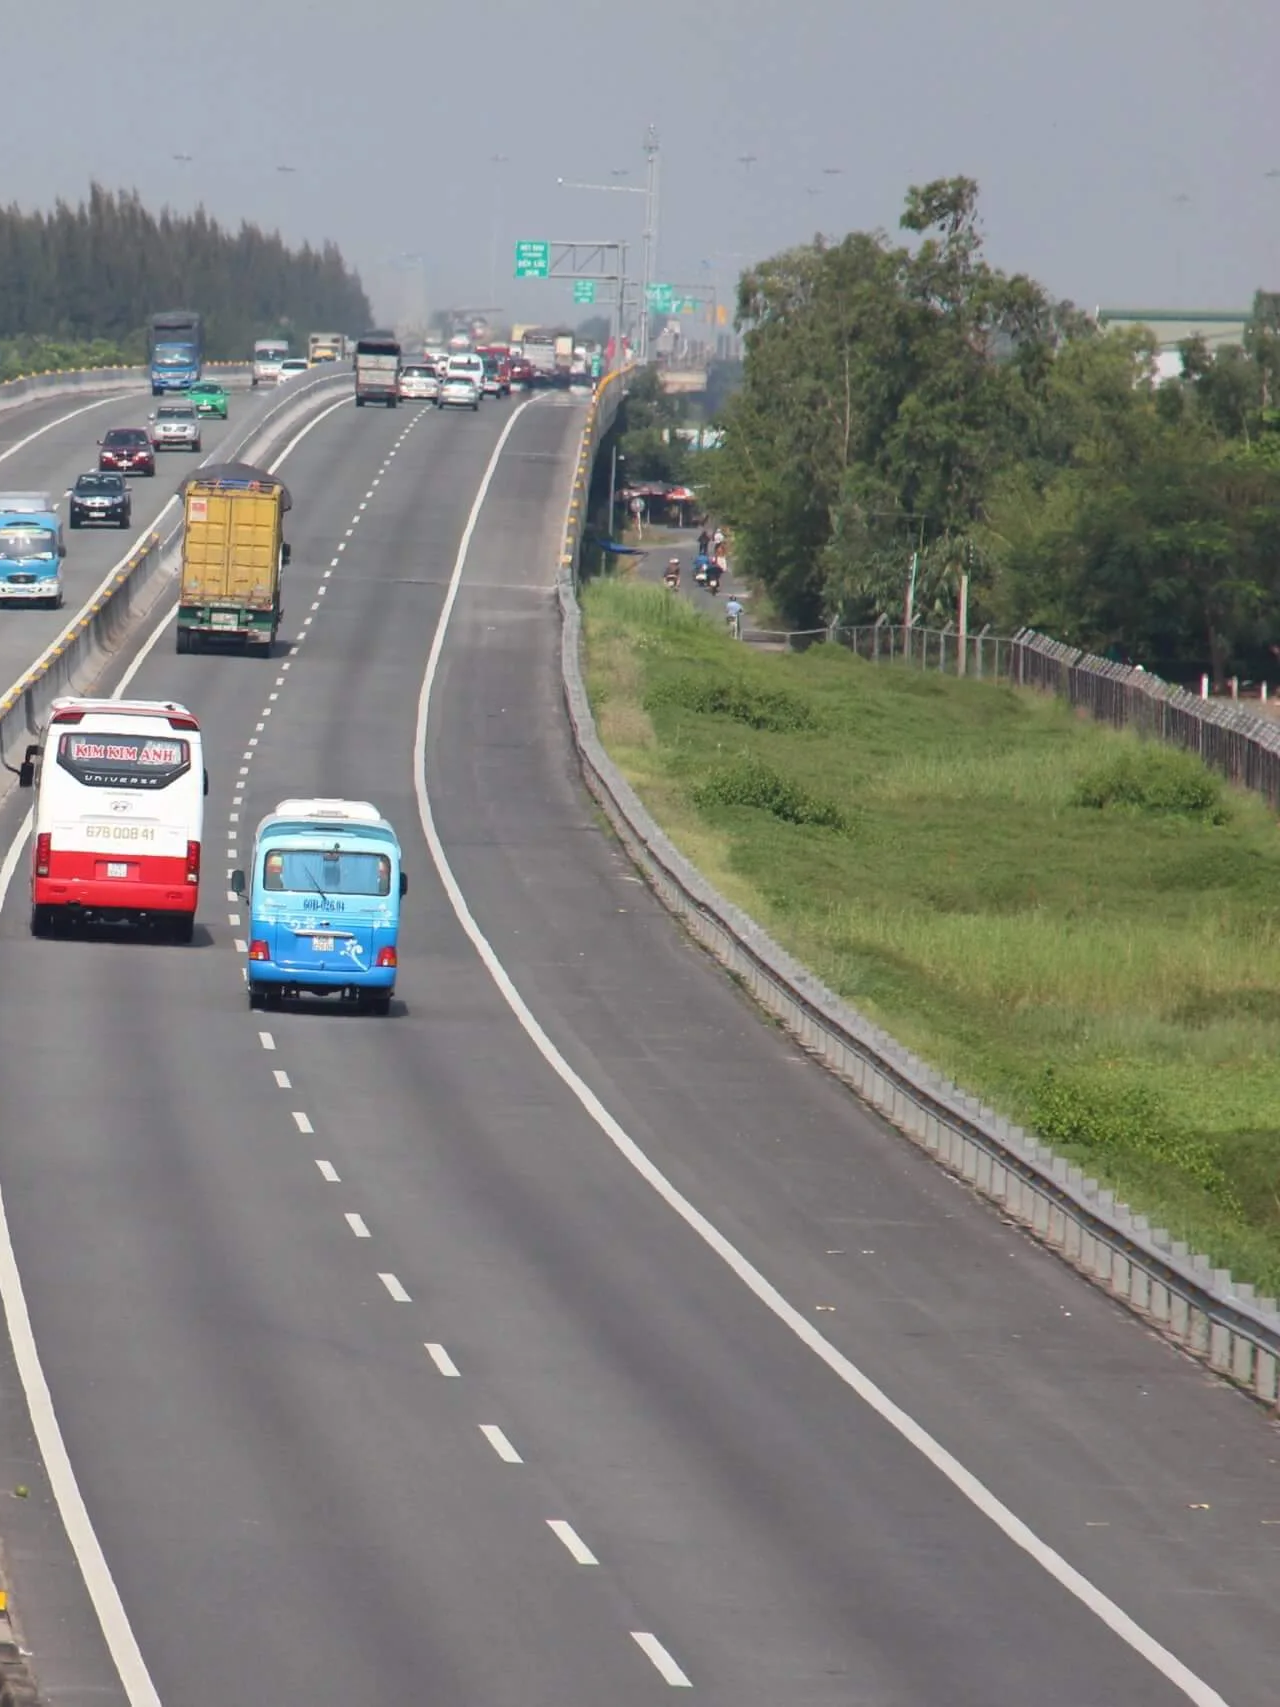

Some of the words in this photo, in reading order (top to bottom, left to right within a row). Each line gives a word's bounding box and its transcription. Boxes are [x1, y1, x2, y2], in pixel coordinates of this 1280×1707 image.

[75, 744, 105, 759] KIM
[106, 745, 138, 760] KIM
[140, 748, 176, 763] ANH
[113, 827, 138, 840] 008
[141, 828, 154, 841] 41
